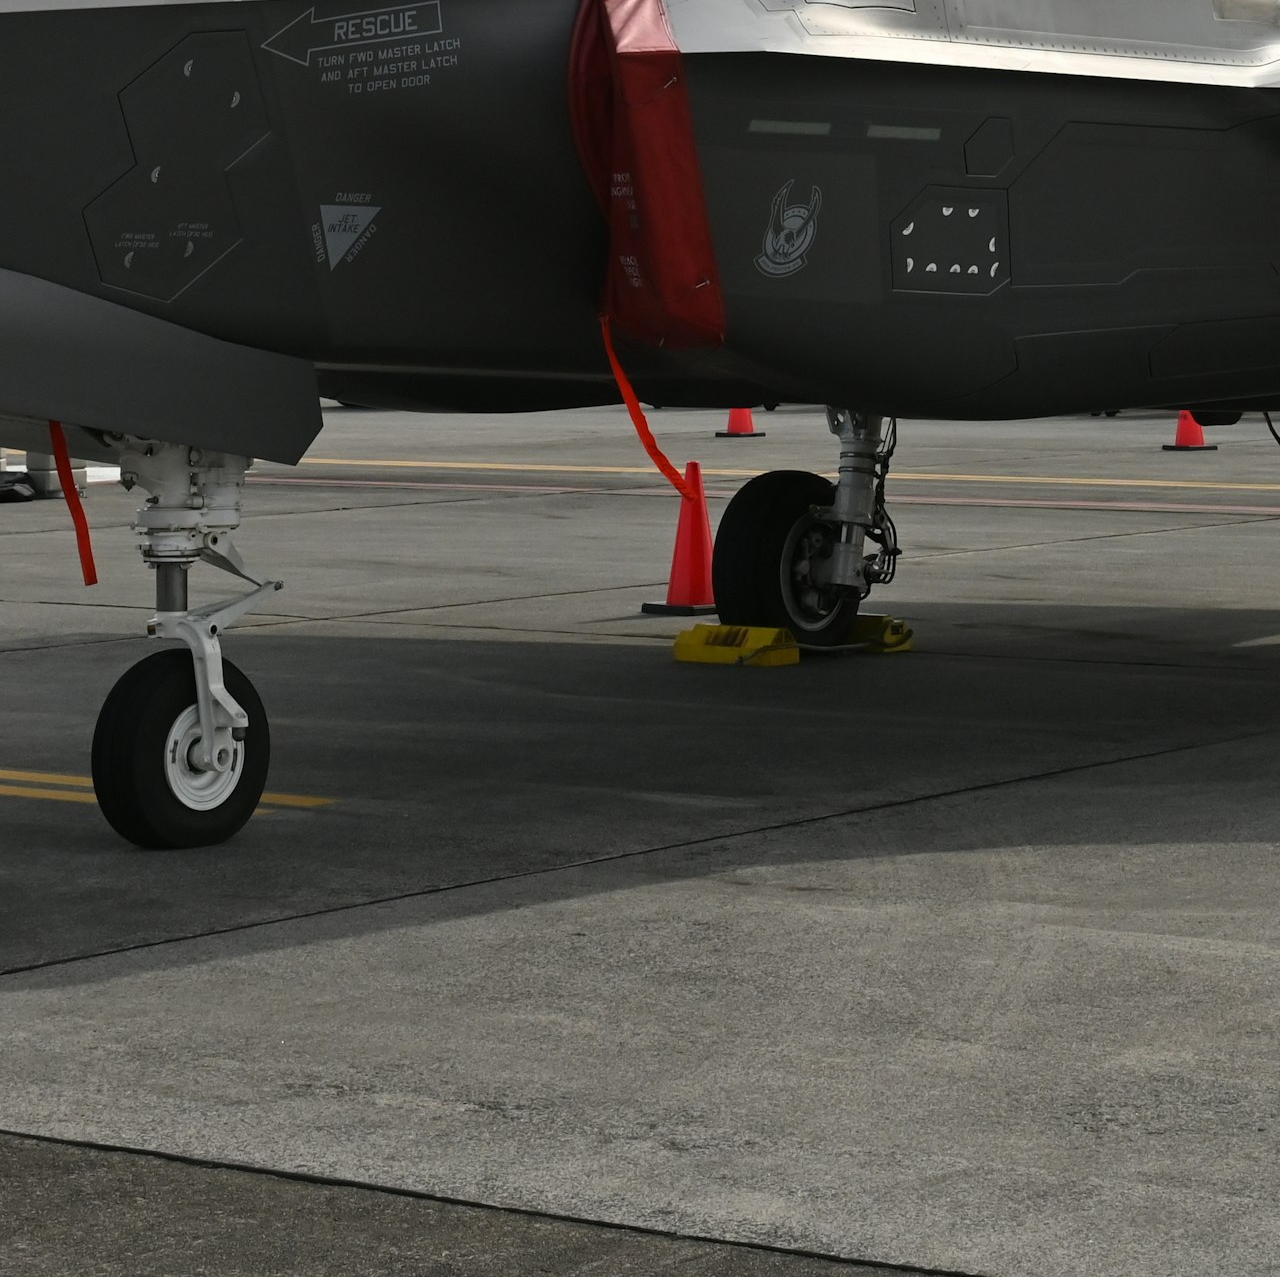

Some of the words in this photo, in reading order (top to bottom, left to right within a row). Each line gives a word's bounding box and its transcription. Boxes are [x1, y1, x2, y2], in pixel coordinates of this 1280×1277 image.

[334, 11, 418, 42] RESCUE
[318, 54, 345, 68] TURN
[349, 50, 375, 64] FWD
[378, 44, 421, 60] MASTER
[425, 38, 461, 54] LATCH
[321, 70, 341, 83] AND
[347, 66, 369, 80] AFT
[373, 61, 417, 76] MASTER
[422, 55, 458, 70] LATCH
[348, 83, 362, 94] TO
[367, 78, 397, 92] OPEN
[401, 74, 431, 88] DOOR
[335, 192, 372, 203] DANGER
[327, 223, 360, 233] INTAKE
[338, 214, 358, 223] JET
[311, 222, 326, 263] DANGER
[344, 224, 377, 263] DANGER
